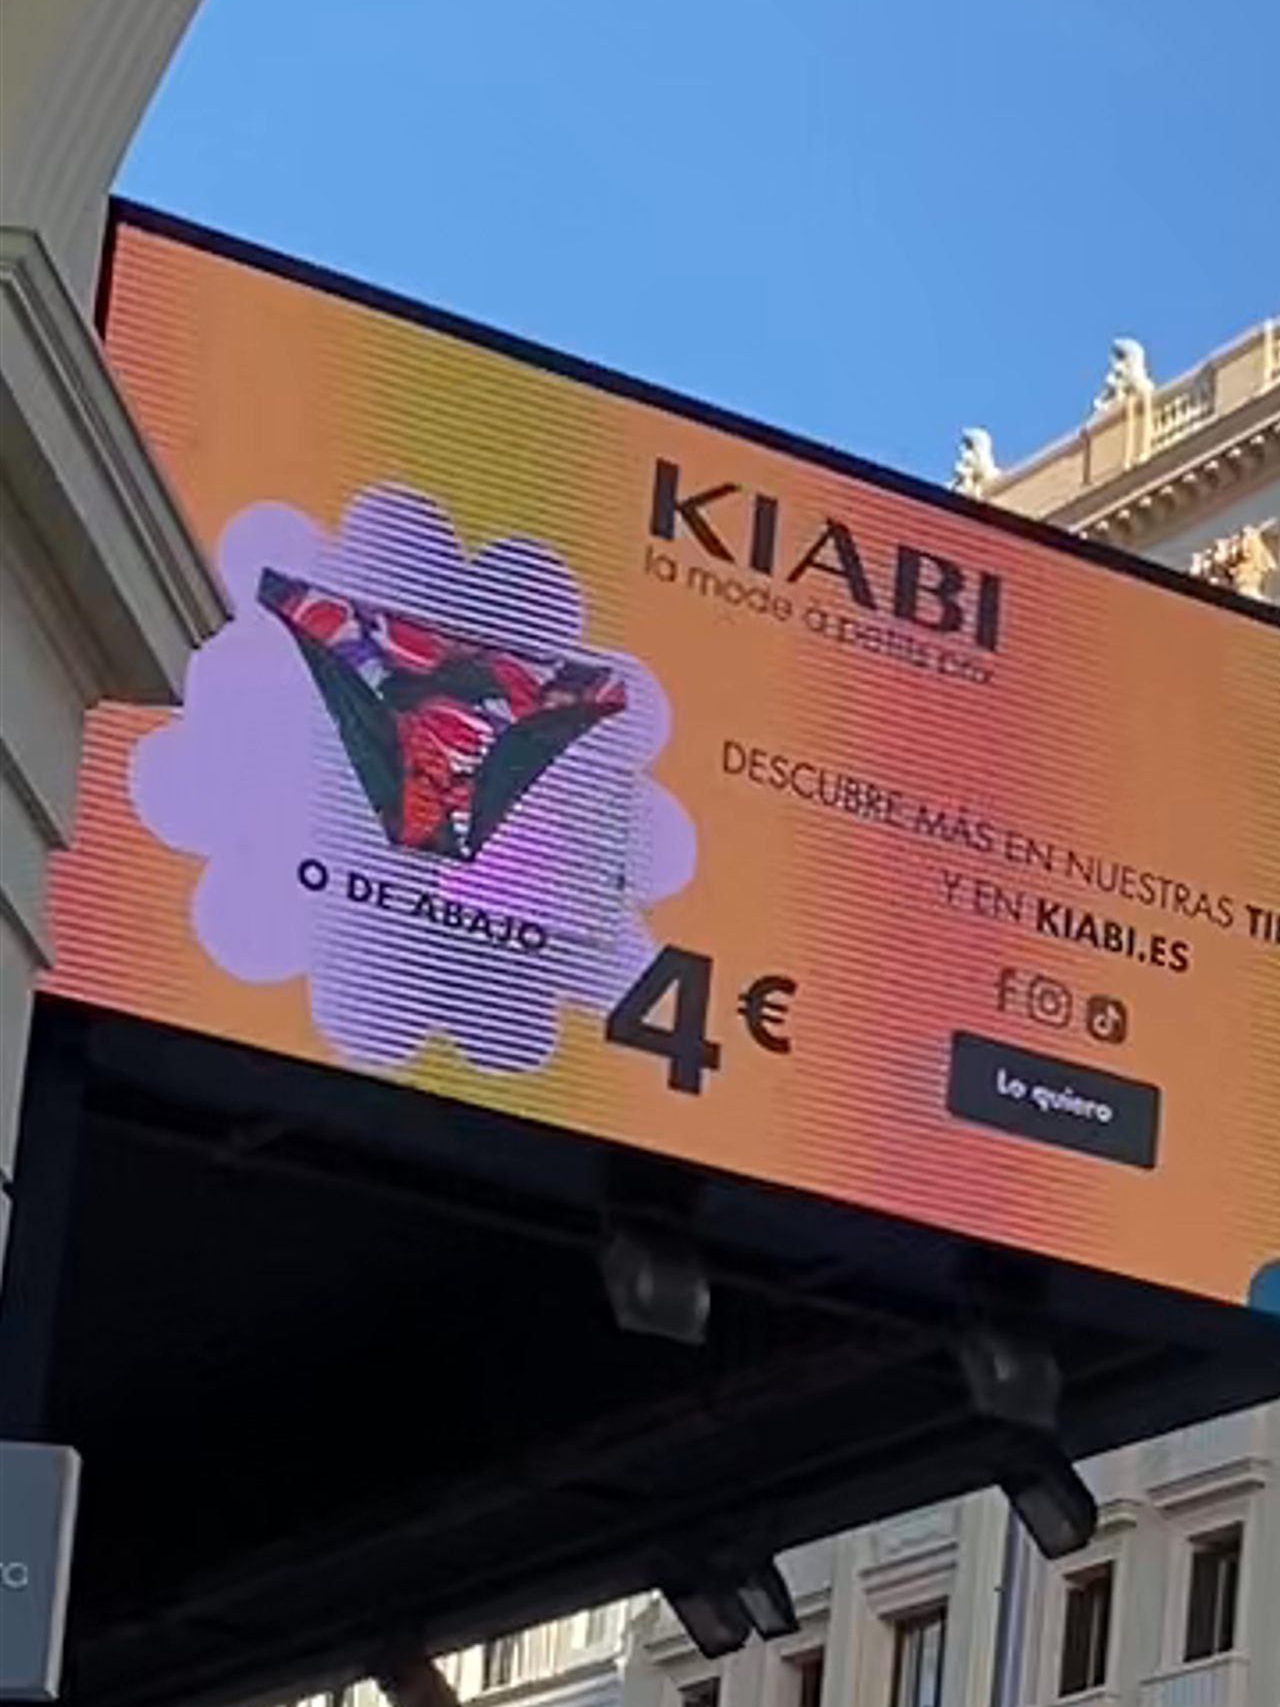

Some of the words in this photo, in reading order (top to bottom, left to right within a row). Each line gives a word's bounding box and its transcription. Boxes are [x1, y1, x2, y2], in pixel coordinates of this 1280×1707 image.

[645, 546, 676, 583] la
[687, 563, 794, 622] mode
[650, 458, 1002, 653] KIABI
[723, 740, 903, 828] DESCUBRE
[914, 803, 997, 852] MÁS
[1005, 830, 1054, 871] EN
[1066, 850, 1234, 928] NUESTRAS
[299, 858, 328, 891] O
[347, 871, 406, 912] DE
[412, 893, 548, 953] ABAJO
[942, 869, 964, 904] Y
[973, 878, 1023, 922] EN
[1036, 897, 1190, 973] KIABI.ES
[606, 944, 720, 1096] 4
[737, 974, 797, 1054] €
[997, 1069, 1026, 1099] Lo
[1033, 1083, 1113, 1124] quiero
